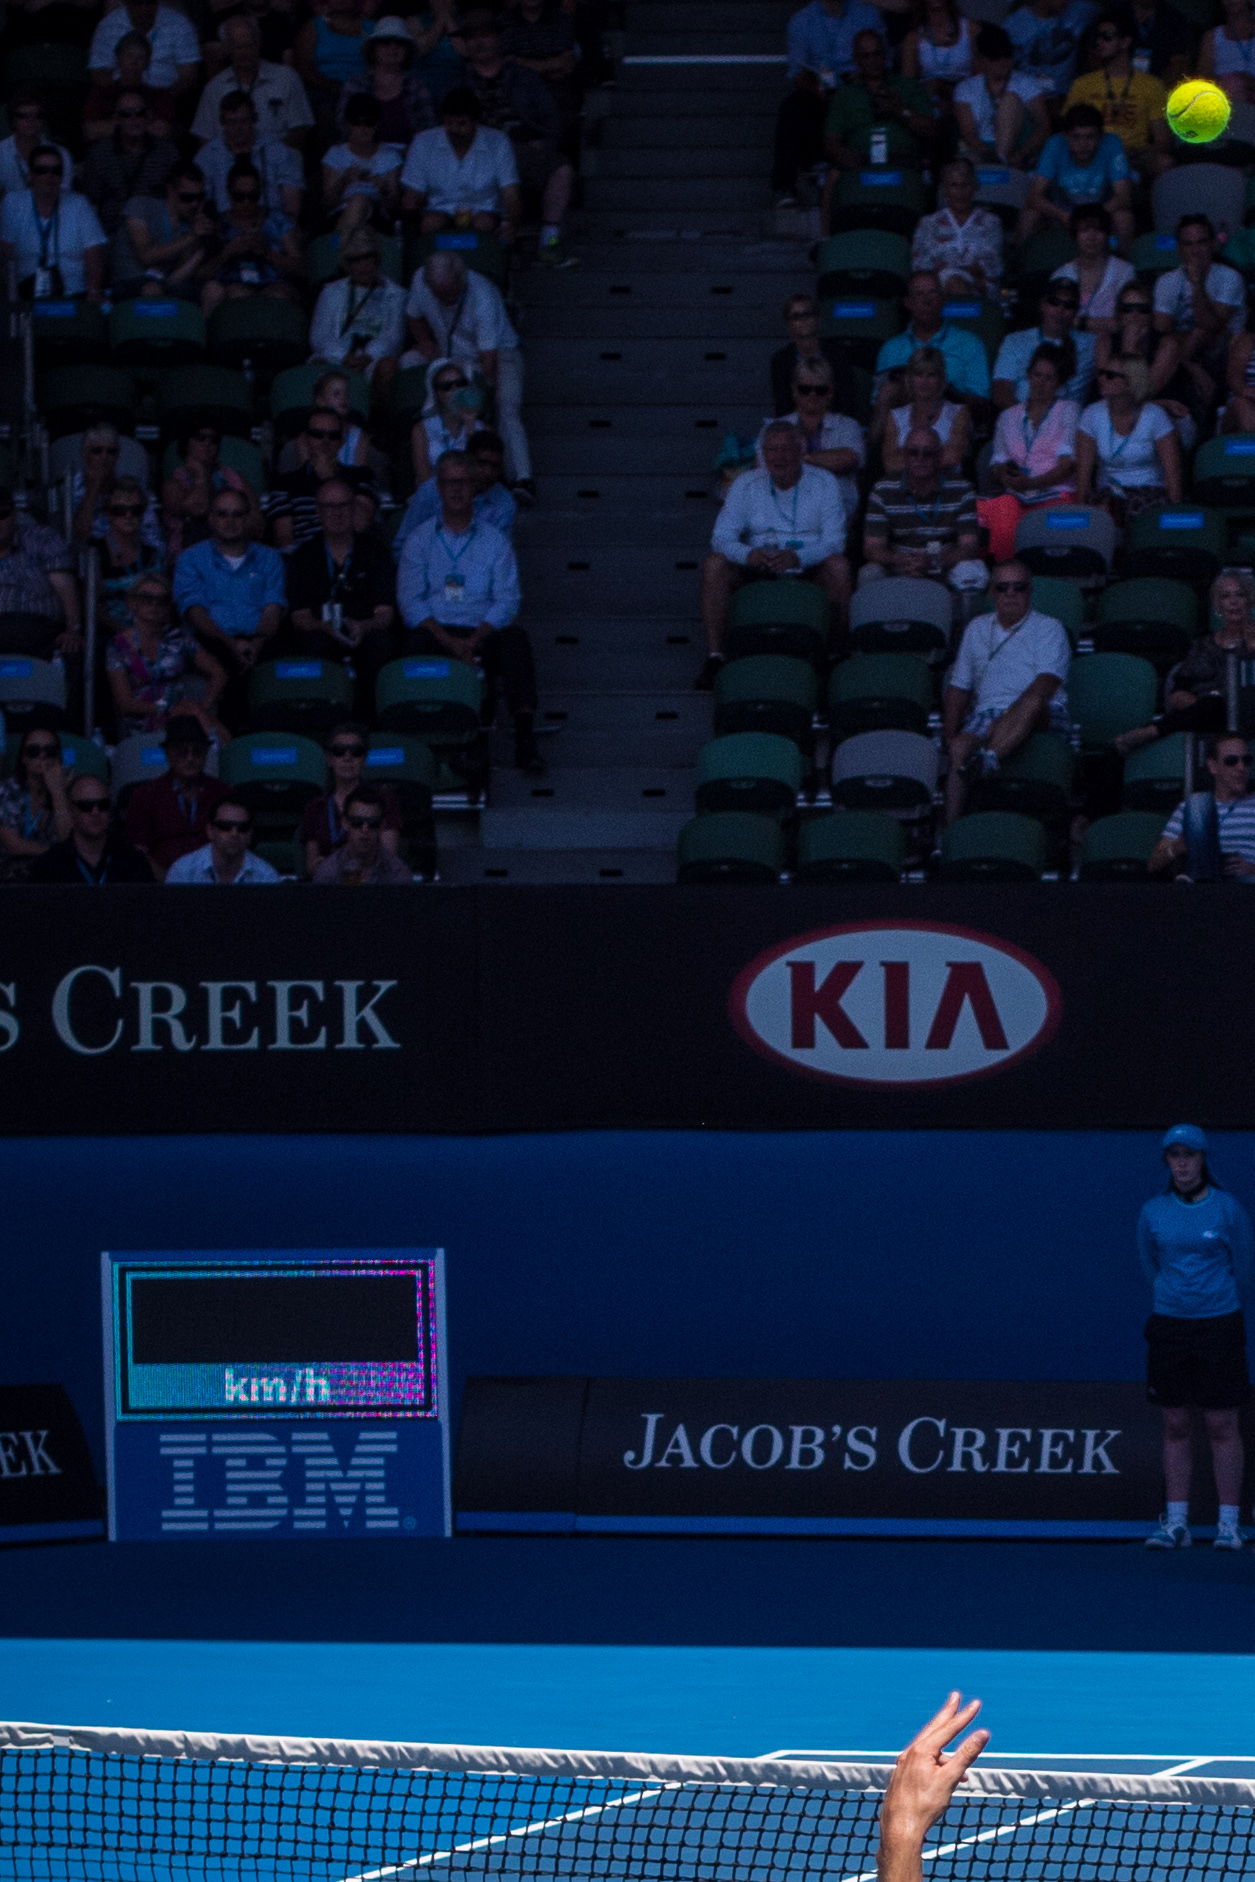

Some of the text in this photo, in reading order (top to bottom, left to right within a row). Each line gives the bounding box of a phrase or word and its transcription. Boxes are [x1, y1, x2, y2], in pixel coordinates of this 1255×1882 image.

[52, 965, 401, 1054] CREEK
[786, 961, 1010, 1050] KIA
[225, 1368, 330, 1404] km/h
[160, 1432, 399, 1530] IBM
[623, 1413, 1122, 1474] JACOB'S CREEK
